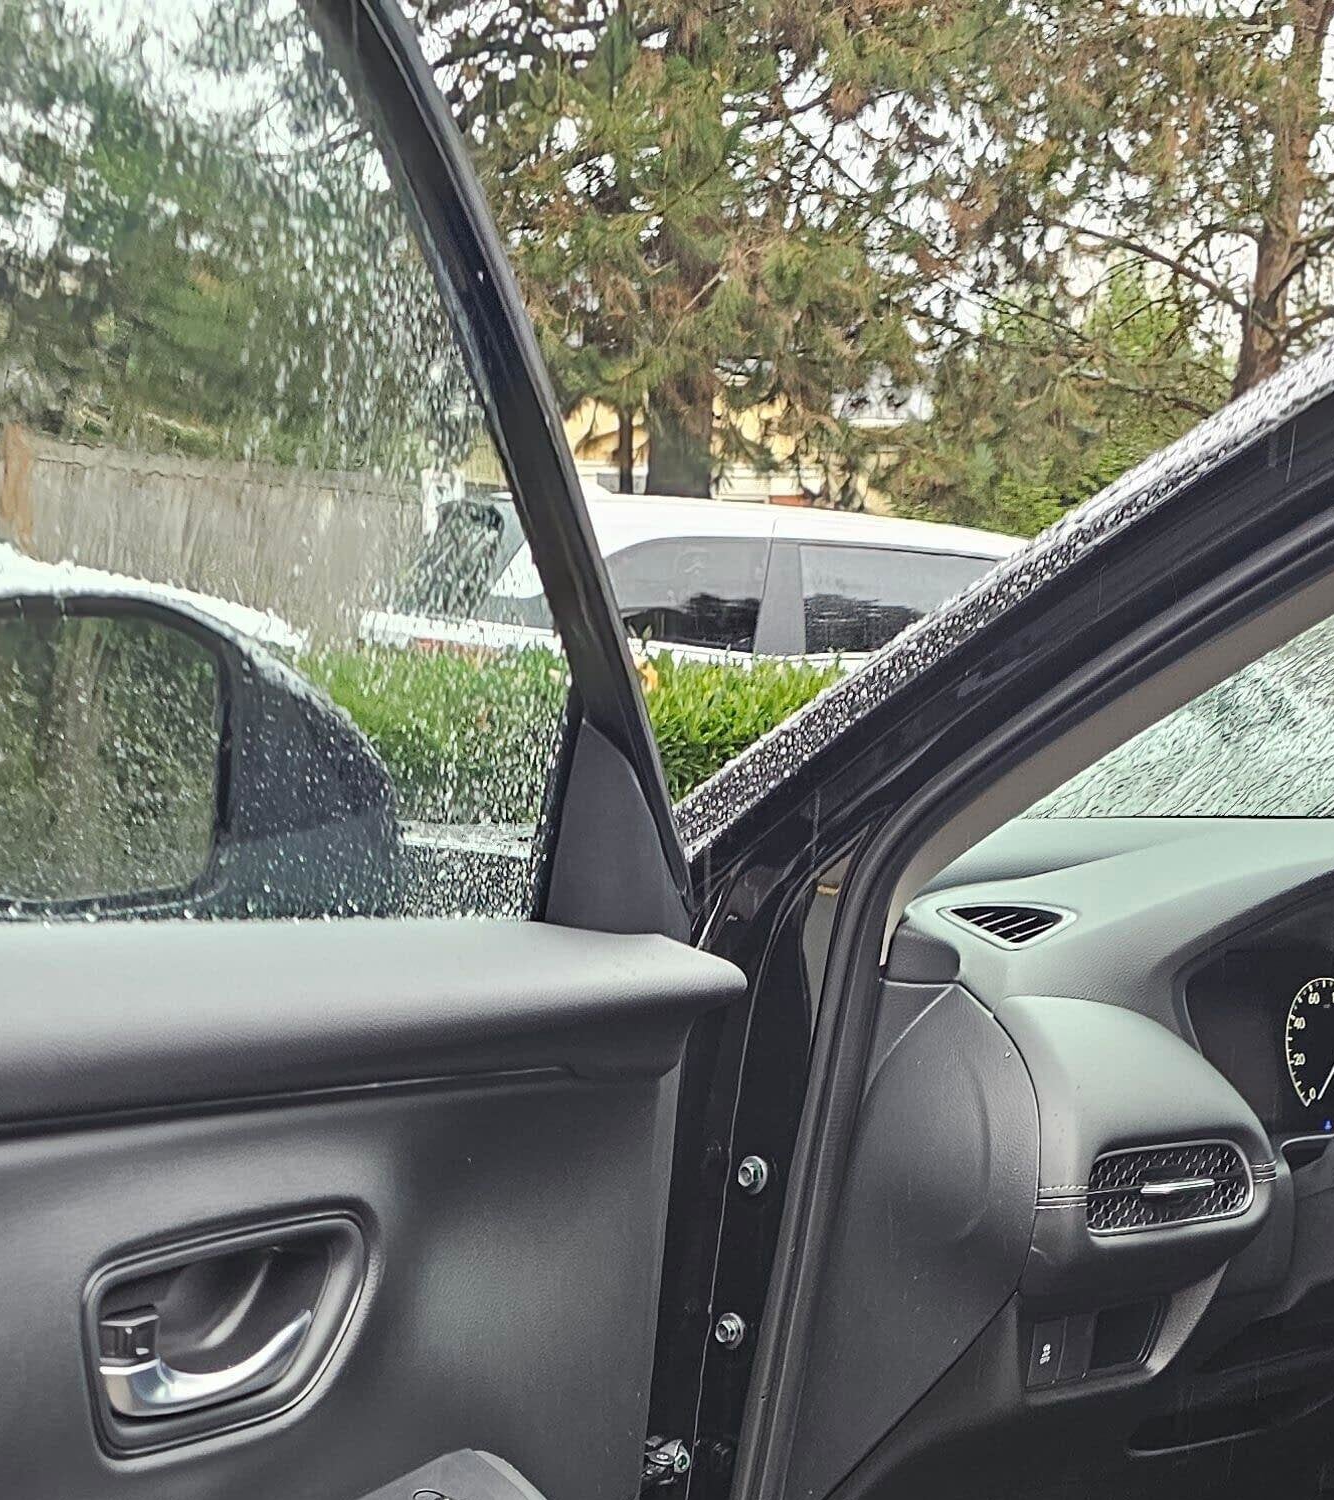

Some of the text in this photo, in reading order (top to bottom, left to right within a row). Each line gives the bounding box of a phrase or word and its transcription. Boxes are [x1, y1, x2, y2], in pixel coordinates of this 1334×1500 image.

[1308, 992, 1320, 1005] 60
[1293, 1016, 1306, 1029] 40
[1293, 1053, 1306, 1066] 20
[1309, 1087, 1316, 1100] 0
